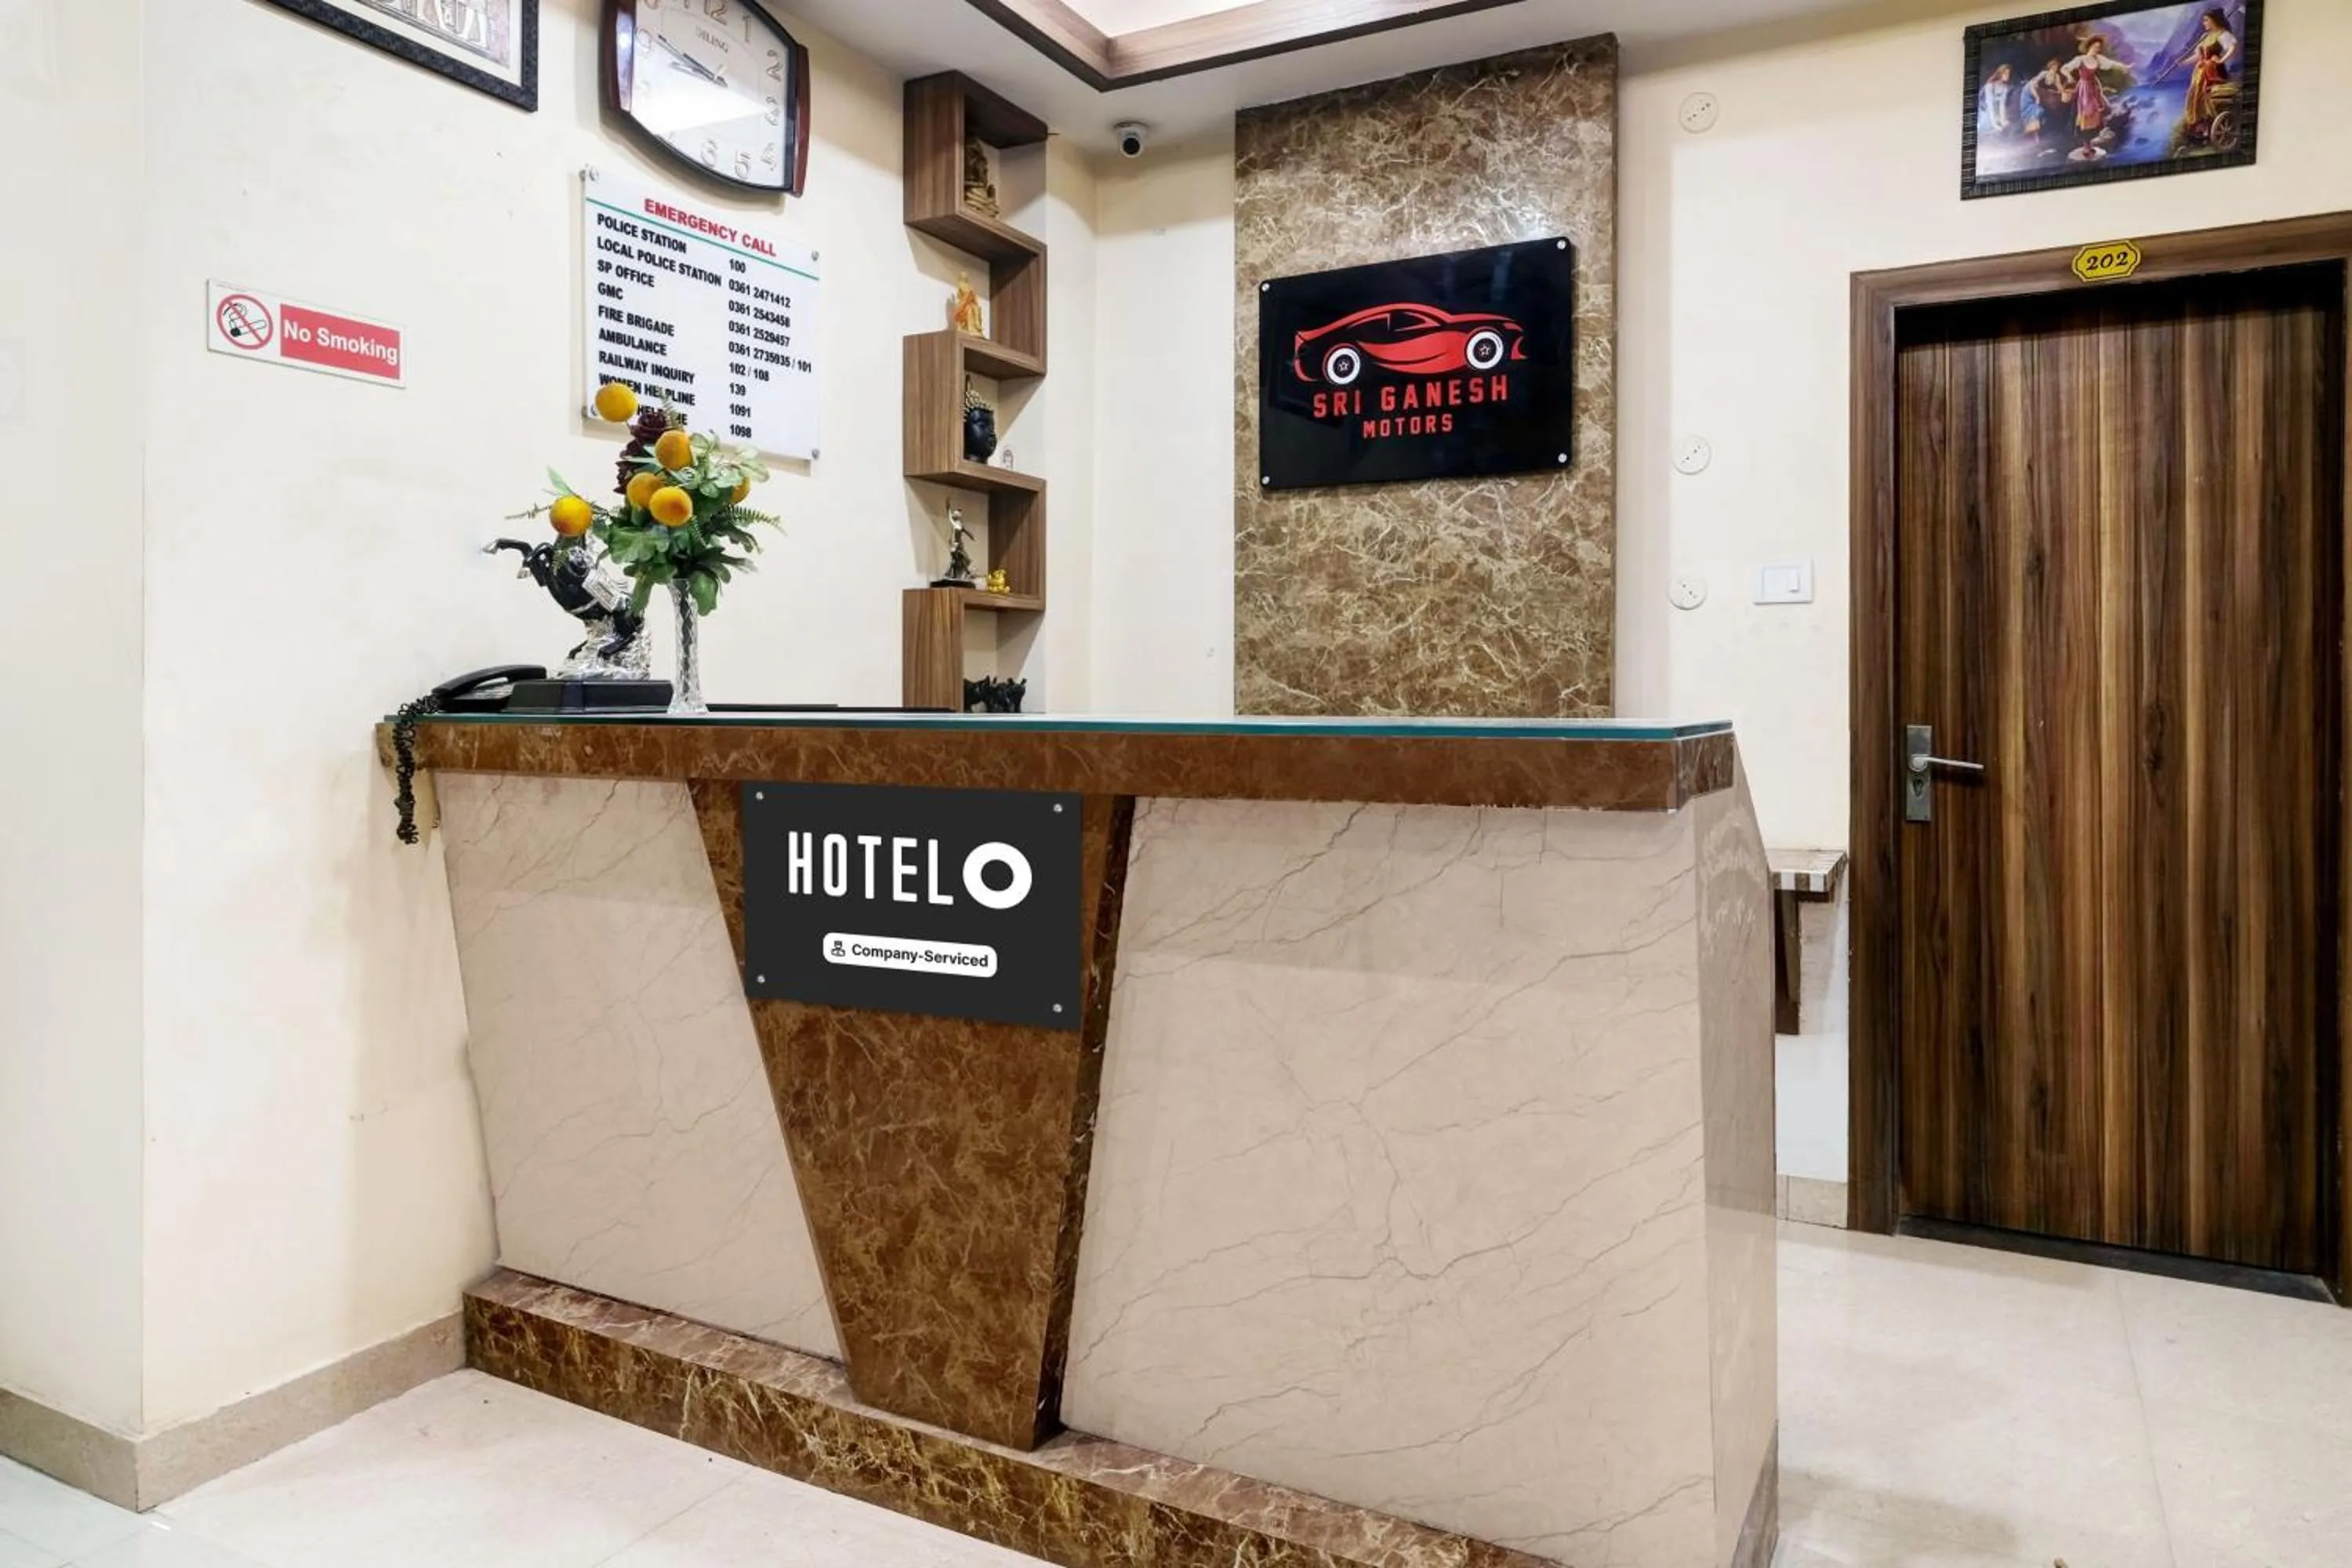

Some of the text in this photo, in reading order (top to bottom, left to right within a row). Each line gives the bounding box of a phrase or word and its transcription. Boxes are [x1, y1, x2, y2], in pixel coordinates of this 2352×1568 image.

[597, 212, 746, 274] POLICE STATION 100
[644, 198, 777, 257] EMERGENCY CALL
[597, 236, 790, 308] LOCAL POLICE STATION 0361 2471412
[2086, 252, 2128, 270] 202
[597, 260, 612, 273] SP
[615, 264, 655, 288] OFFICE
[729, 299, 750, 317] 0361
[597, 282, 623, 300] GMC
[729, 321, 750, 337] 0361
[283, 320, 397, 365] No Smoking
[598, 305, 623, 322] FIRE
[626, 314, 674, 336] BRIGADE
[729, 341, 750, 358] 0361
[797, 360, 811, 373] 101
[599, 328, 667, 356] AMBULANCE
[729, 362, 746, 376] 102
[753, 368, 769, 382] 108
[599, 351, 746, 397] RAILWAY INQUIRY 139
[1313, 375, 1509, 418] SRI GANESH
[644, 382, 695, 406] HELPLINE
[729, 404, 751, 419] 1091
[1363, 413, 1453, 438] MOTORS
[729, 424, 752, 439] 1098
[788, 831, 954, 906] HOTEL
[851, 943, 989, 968] Company-Serviced
